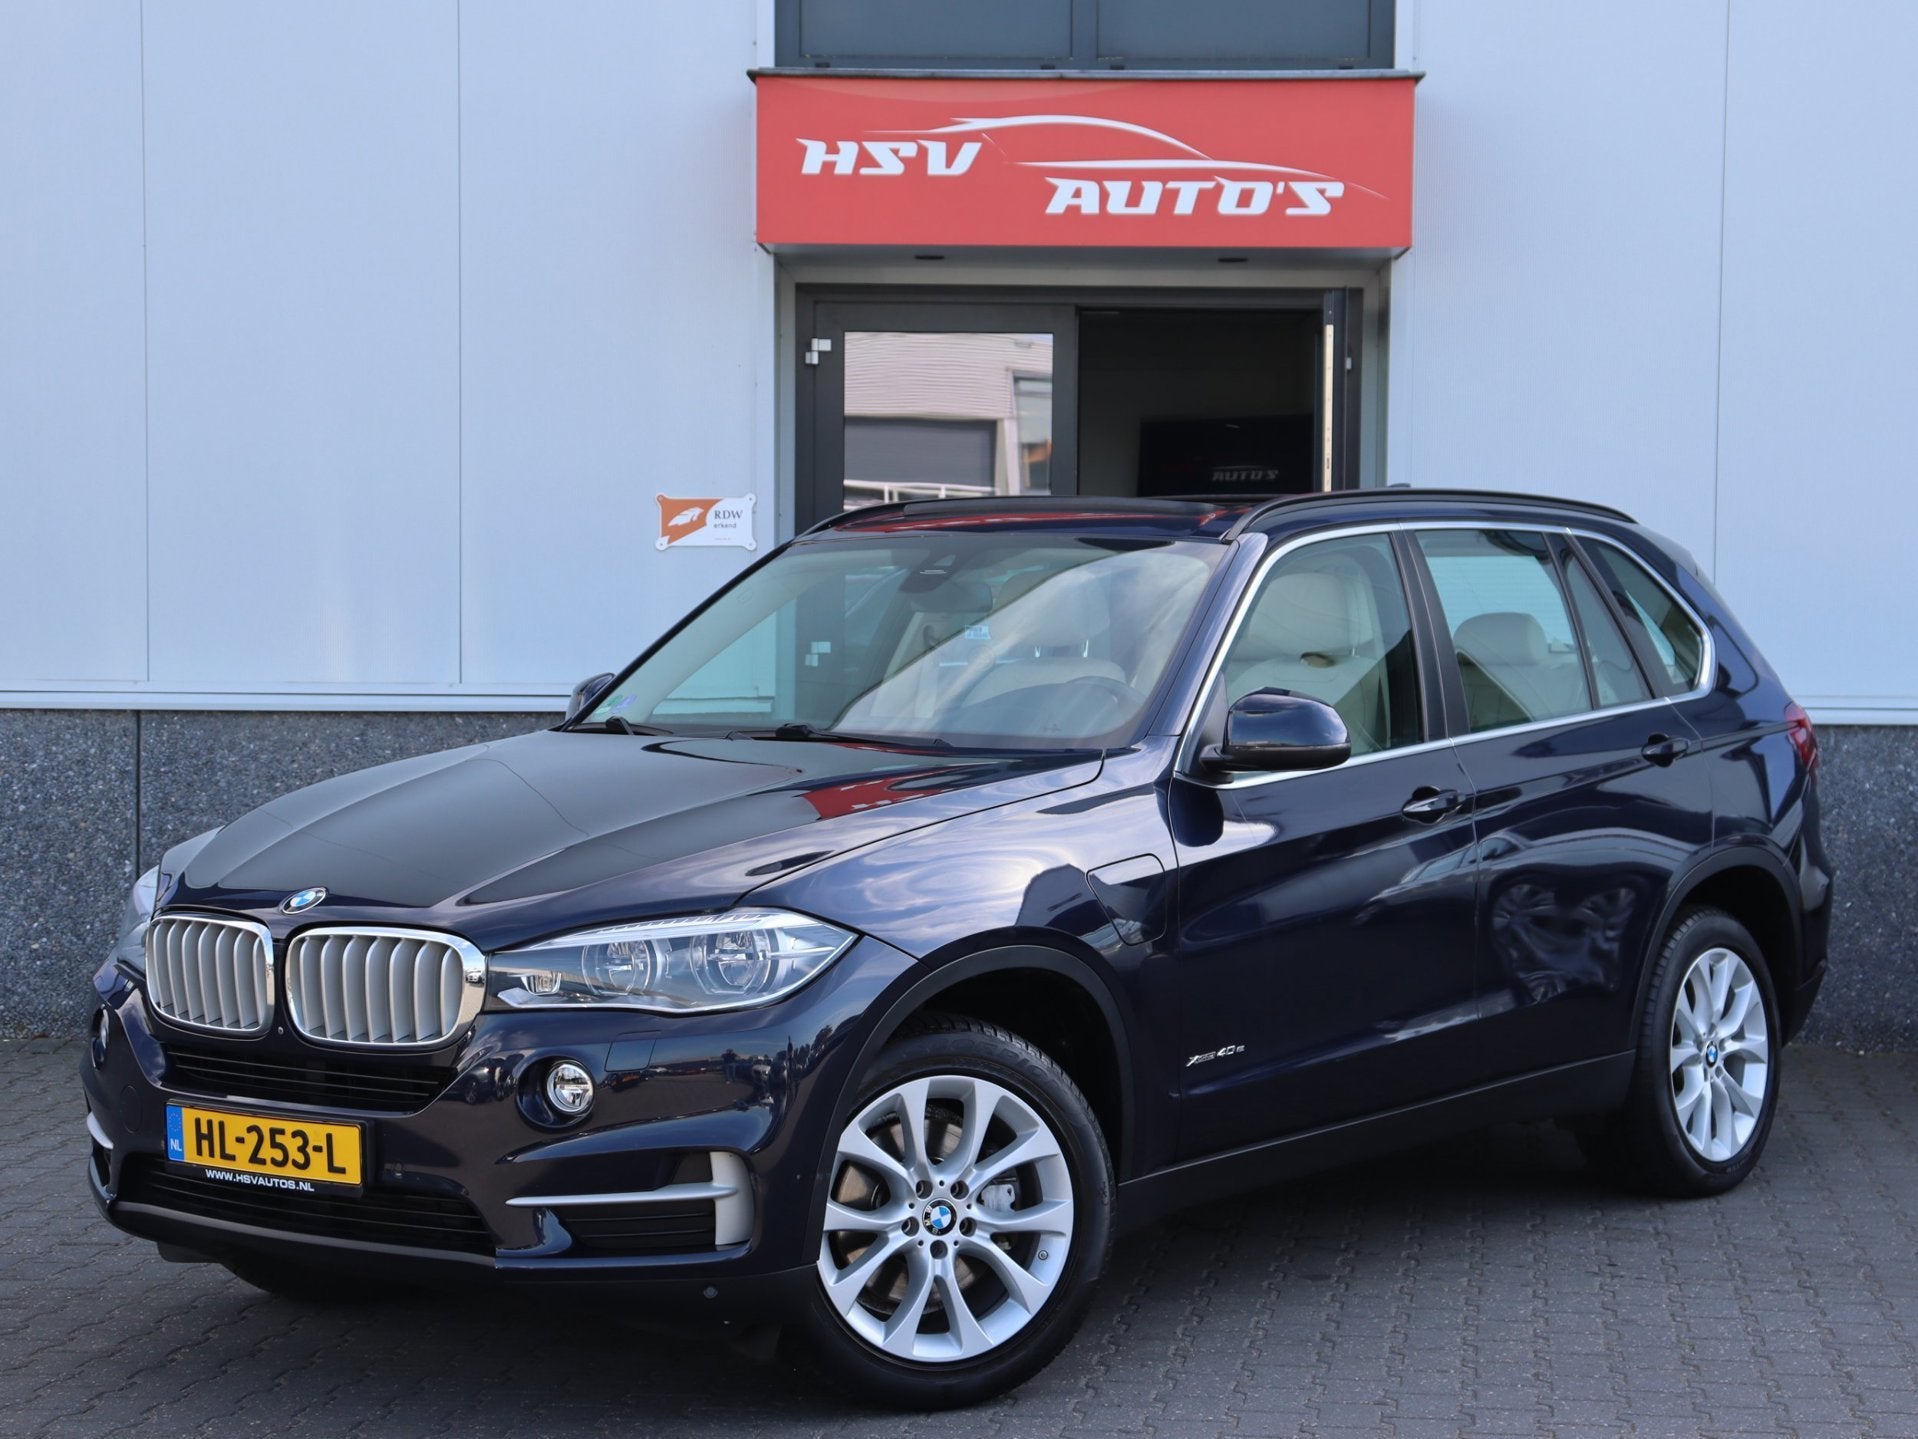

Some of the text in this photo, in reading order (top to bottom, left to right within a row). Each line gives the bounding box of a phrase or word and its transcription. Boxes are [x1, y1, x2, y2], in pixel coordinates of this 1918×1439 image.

[795, 138, 983, 176] HSV
[1043, 176, 1345, 216] AUTO'S
[714, 509, 743, 520] RDW
[170, 1138, 183, 1152] NL
[194, 1117, 347, 1175] HL-253-L
[205, 1169, 316, 1192] WWW.HSVAUTOS.NL
